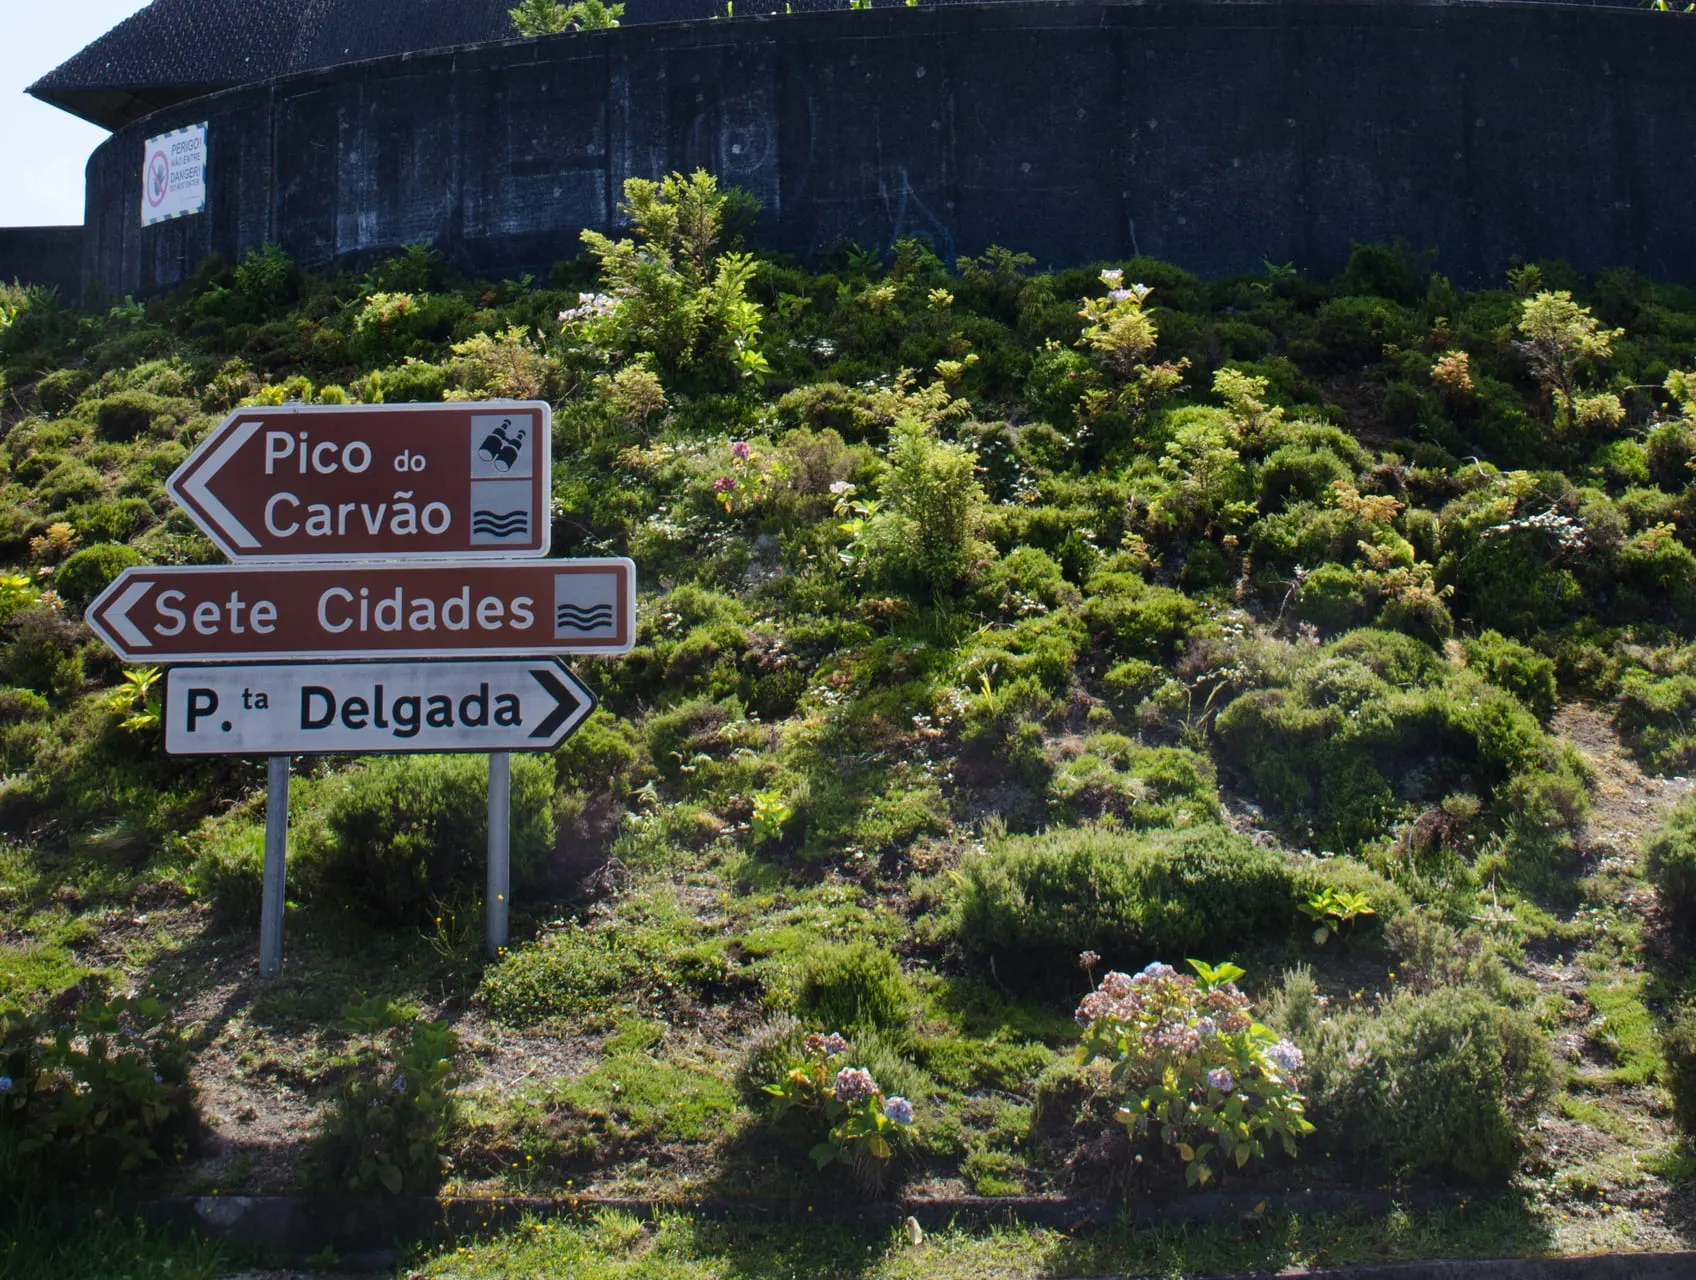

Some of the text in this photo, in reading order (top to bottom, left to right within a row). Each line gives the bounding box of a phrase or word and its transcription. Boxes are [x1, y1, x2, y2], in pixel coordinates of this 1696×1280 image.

[171, 137, 202, 156] PERIGO!
[170, 165, 201, 183] DANGER!
[264, 430, 426, 475] Pico do
[264, 490, 452, 537] Carvão
[153, 585, 536, 637] Sete Cidades
[300, 682, 523, 738] Delgada
